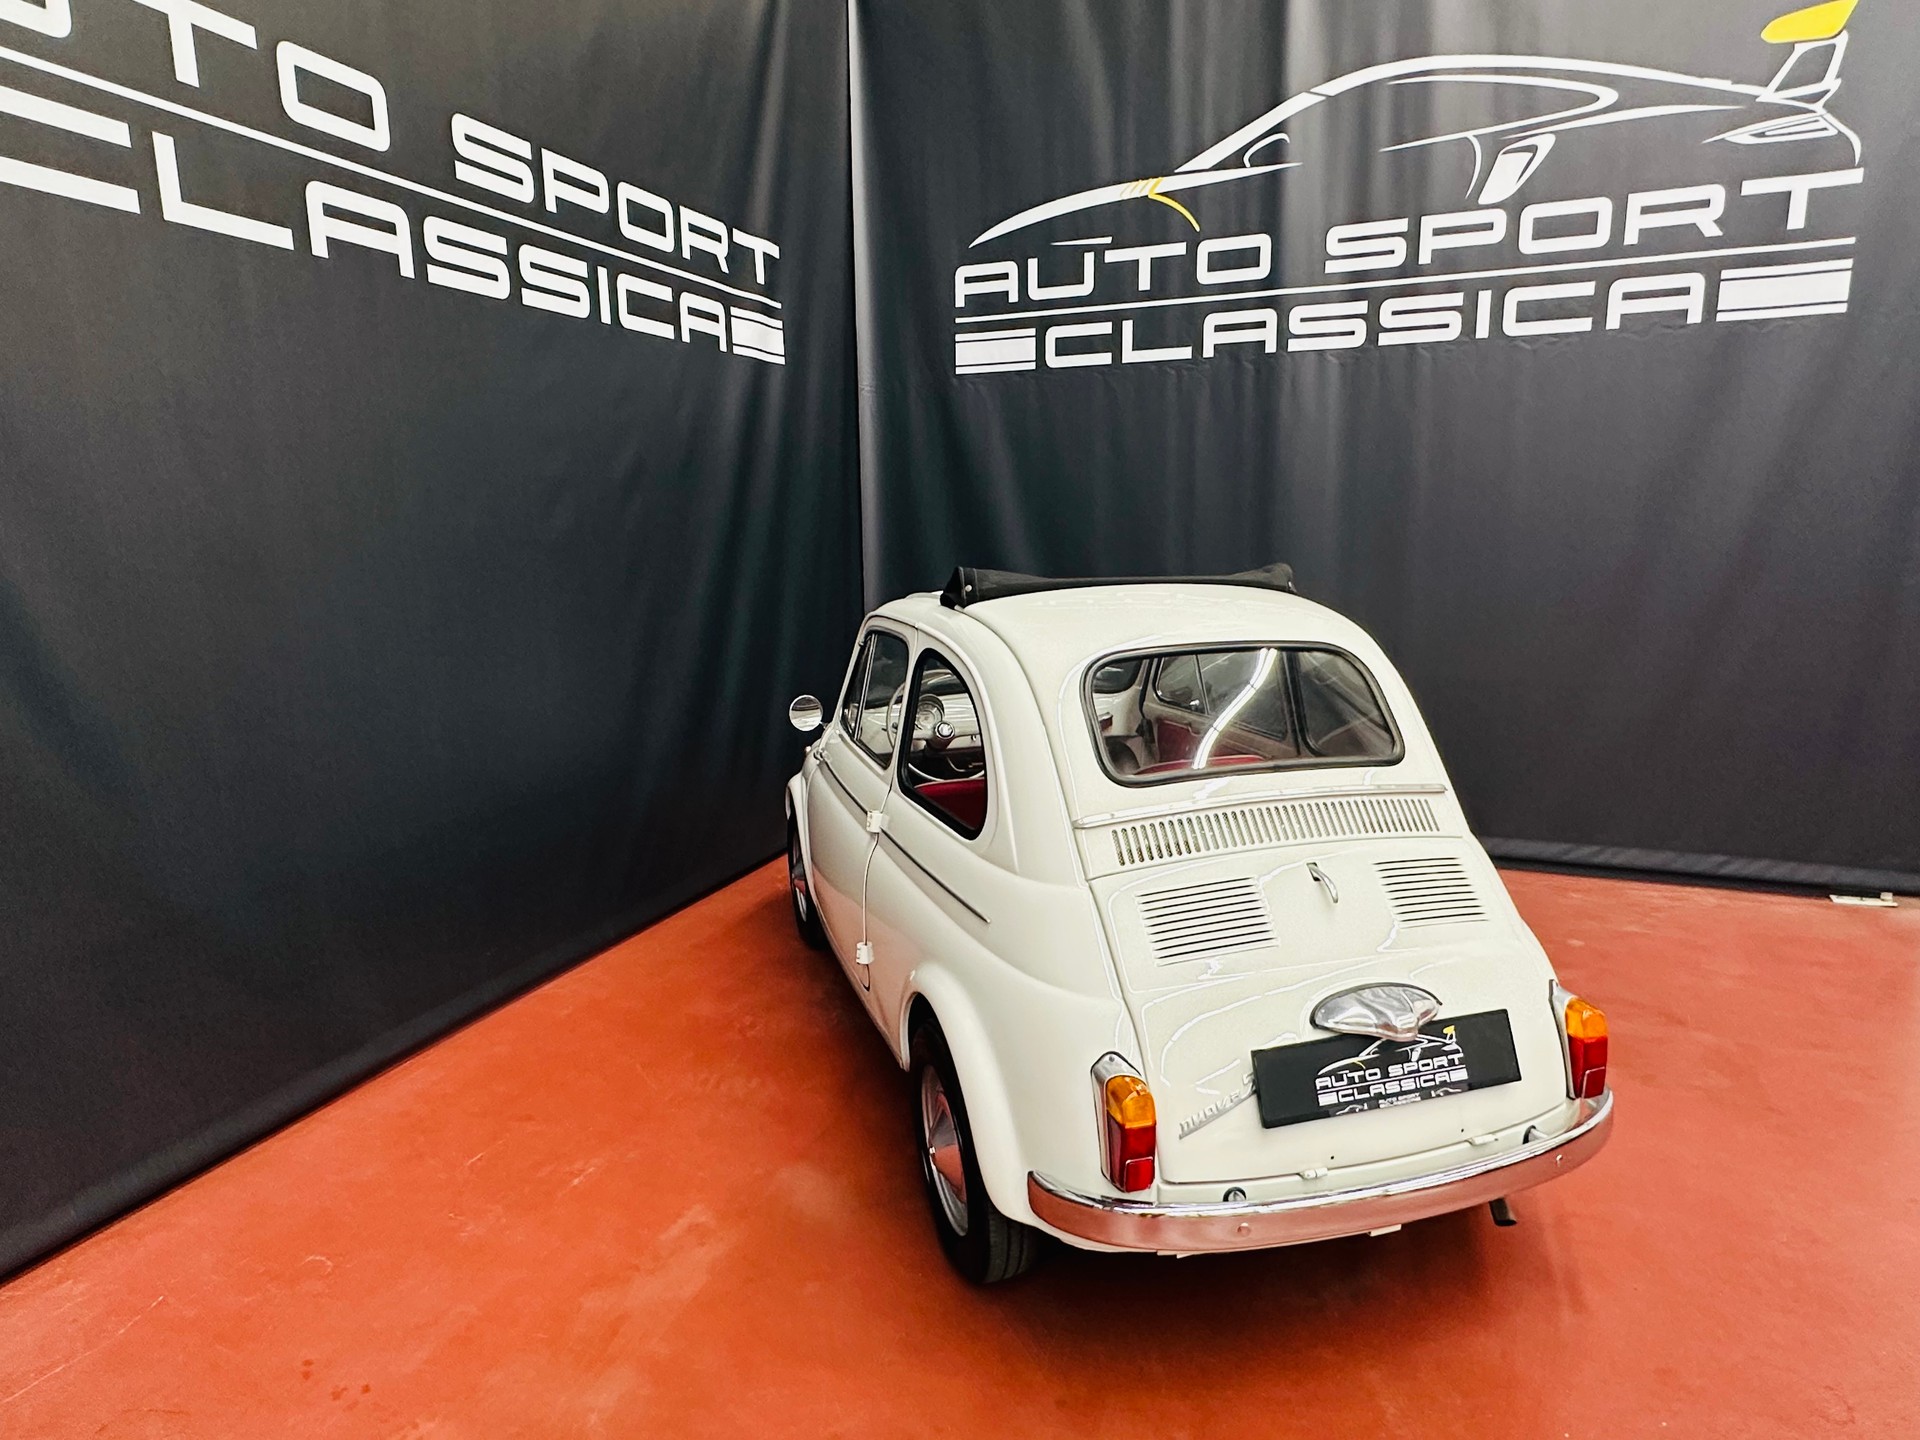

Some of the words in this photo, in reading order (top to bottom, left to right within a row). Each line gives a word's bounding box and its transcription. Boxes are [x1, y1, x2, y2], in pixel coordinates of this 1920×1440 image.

[451, 113, 780, 285] SPORT
[954, 233, 1272, 308] AUTO
[1324, 166, 1865, 274] SPORT
[1045, 272, 1706, 369] CLASSICA
[1315, 1067, 1382, 1090] AUTO
[1388, 1052, 1464, 1078] SPORT
[1337, 1071, 1451, 1103] CLASSICA
